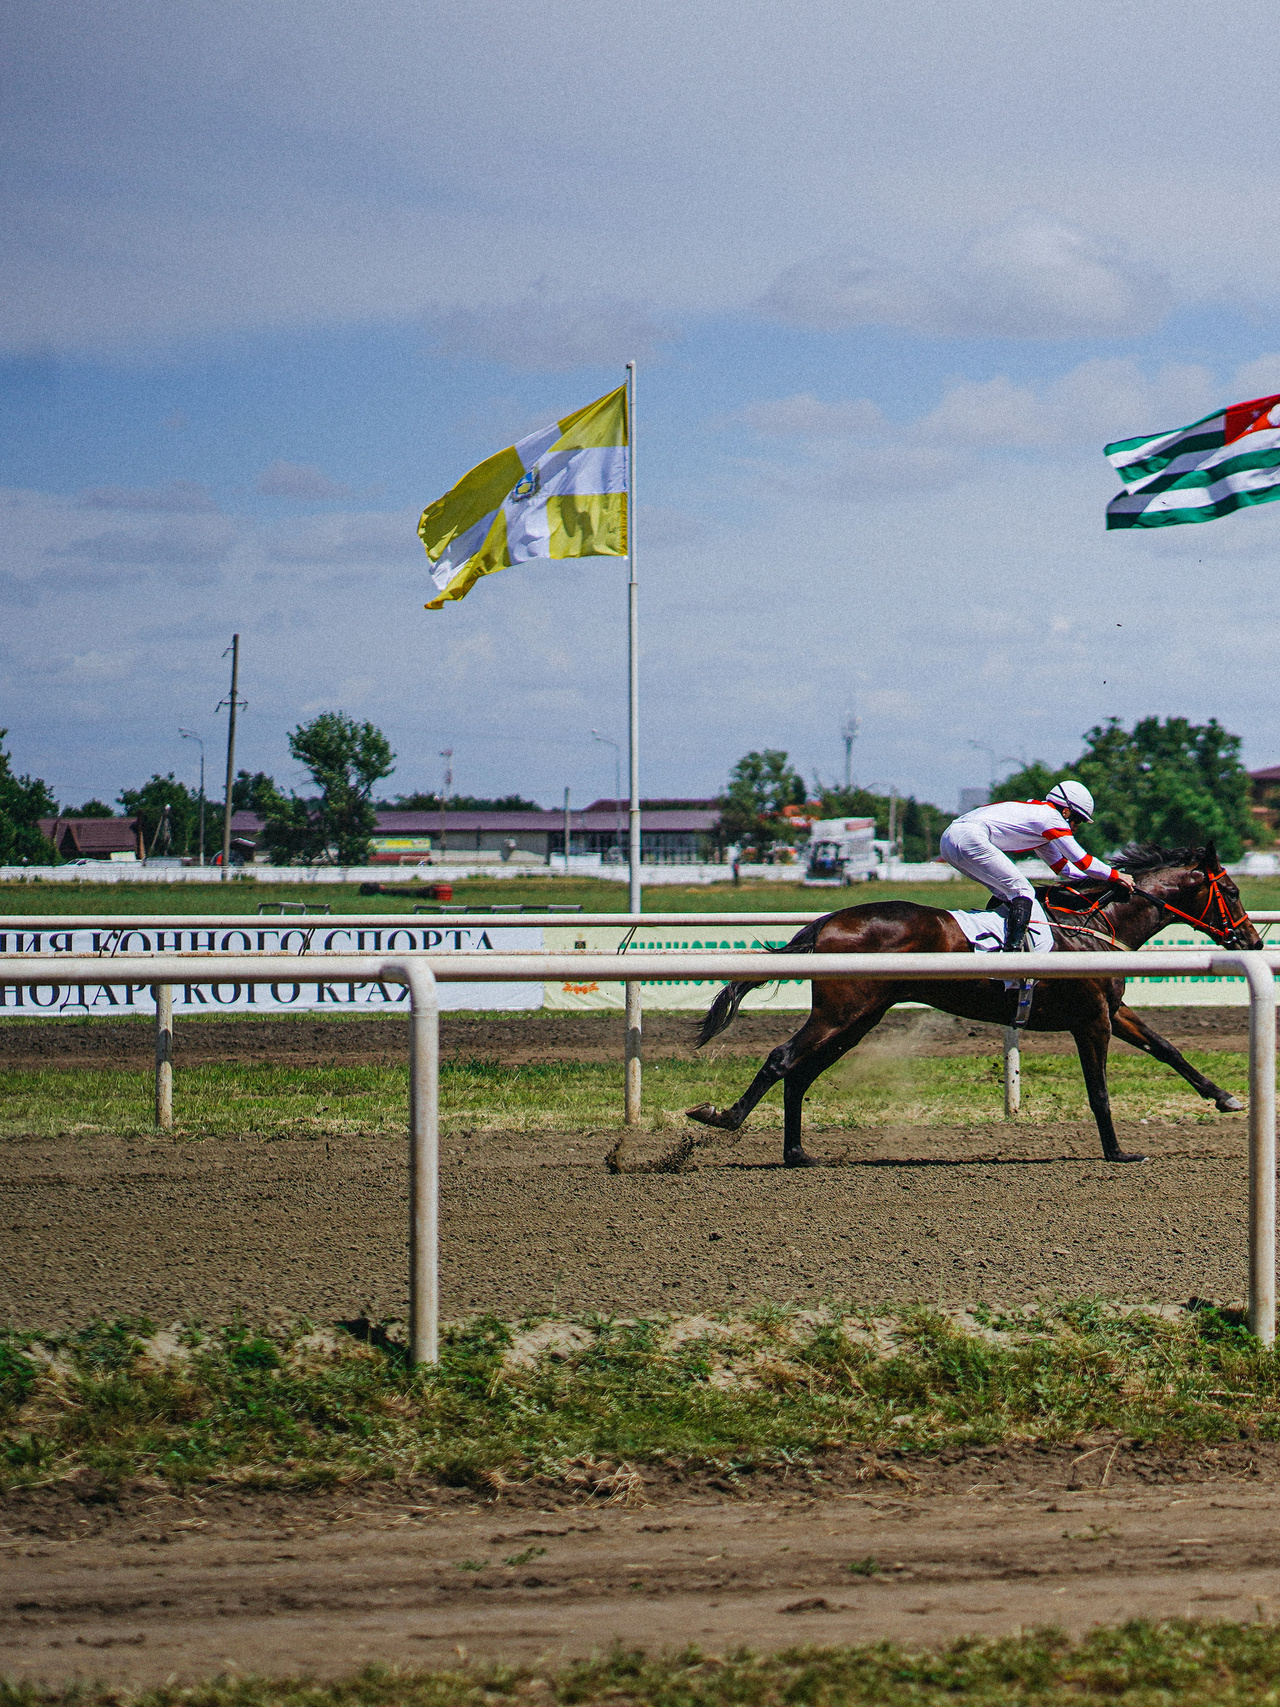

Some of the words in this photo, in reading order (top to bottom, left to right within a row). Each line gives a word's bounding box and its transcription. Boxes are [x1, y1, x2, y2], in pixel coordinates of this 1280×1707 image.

[0, 932, 74, 952] ИЯ
[92, 930, 310, 951] КОННОГО
[324, 929, 494, 950] СПОРТА
